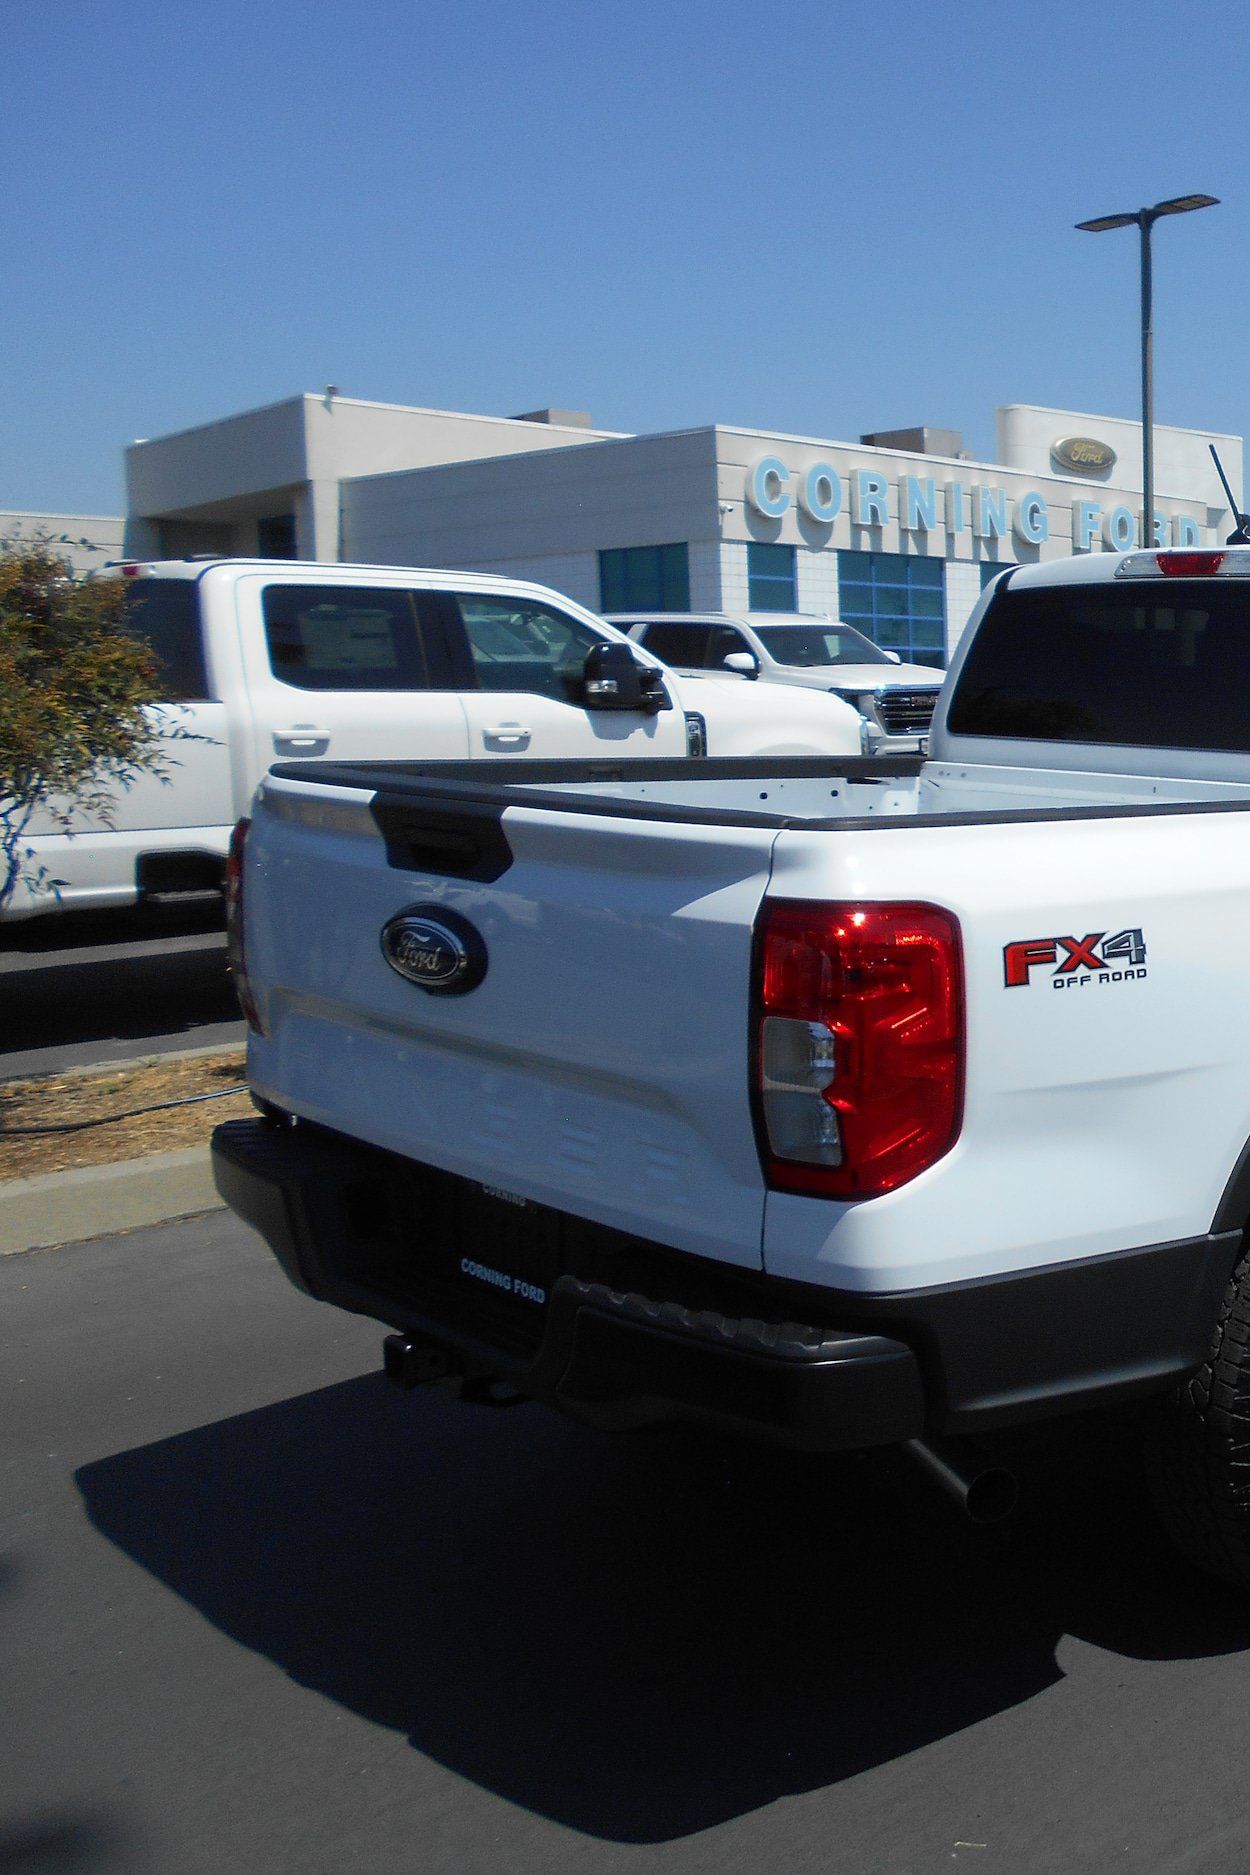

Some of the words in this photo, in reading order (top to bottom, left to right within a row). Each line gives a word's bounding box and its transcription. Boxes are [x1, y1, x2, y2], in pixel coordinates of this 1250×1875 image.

[1071, 442, 1105, 465] Ford
[745, 454, 1049, 545] CORNING
[1072, 500, 1201, 553] FORD
[396, 930, 442, 971] Ford
[1003, 928, 1147, 988] FX4
[1053, 975, 1091, 989] OFF
[1099, 968, 1147, 984] ROAD
[461, 1258, 511, 1290] CORNING
[514, 1279, 545, 1303] FORD
